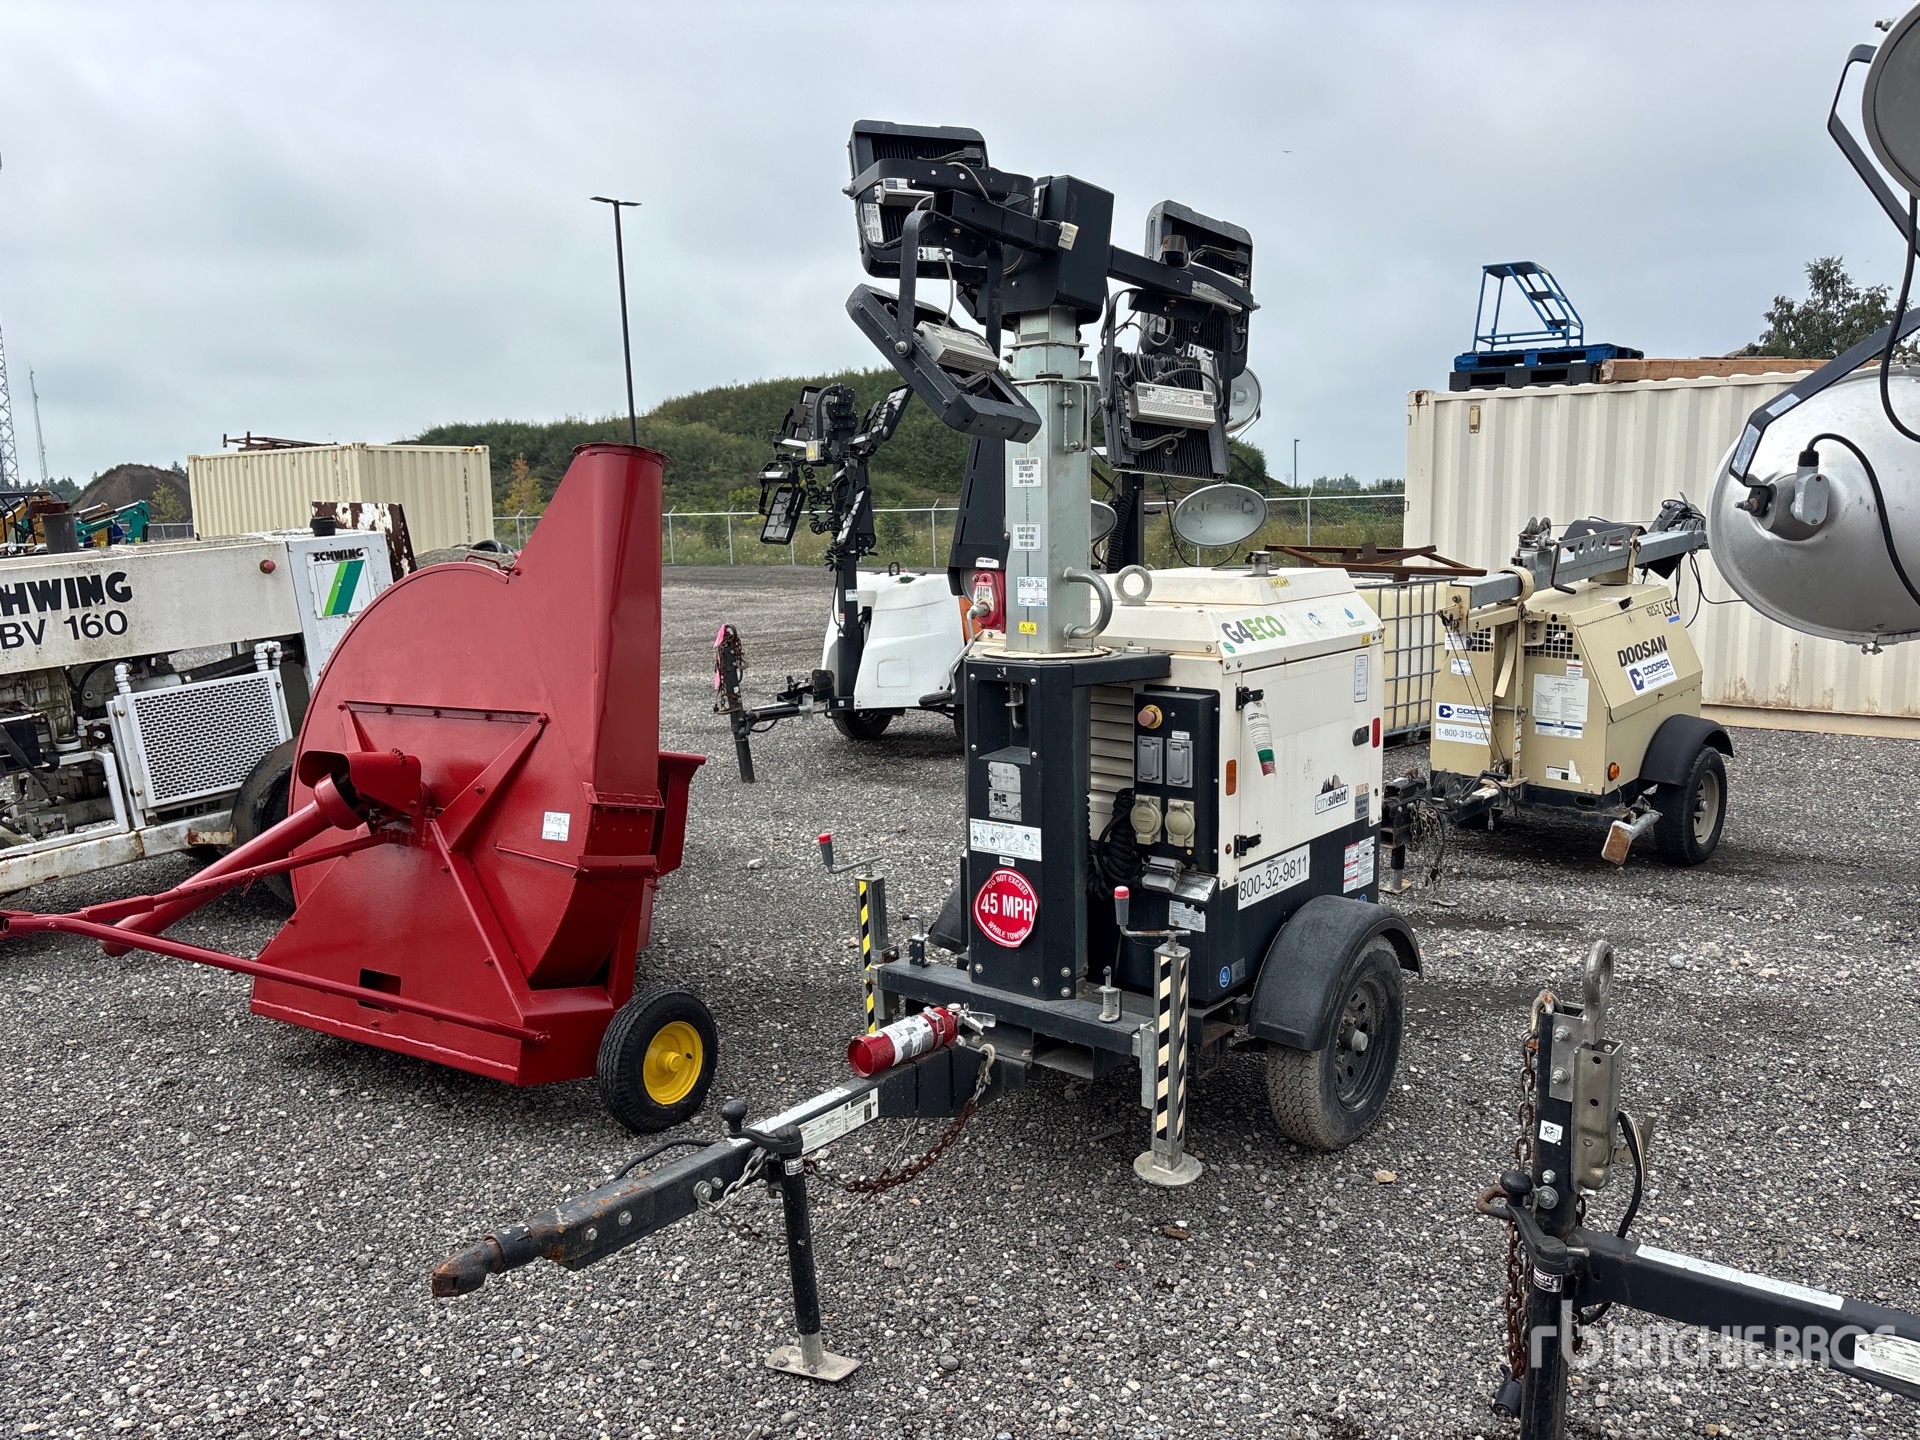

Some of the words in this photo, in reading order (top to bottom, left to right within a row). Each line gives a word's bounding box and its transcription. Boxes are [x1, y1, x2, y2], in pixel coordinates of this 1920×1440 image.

[313, 548, 364, 562] SCHWING
[0, 572, 133, 617] HWING
[63, 610, 128, 641] 160
[1221, 615, 1287, 644] G4ECO
[1617, 635, 1668, 668] DOOSAN
[1642, 659, 1671, 676] COOPER
[987, 880, 996, 889] DO
[1008, 876, 1029, 896] EXCEED
[1240, 854, 1307, 901] 800-32-9811
[980, 892, 999, 915] 45
[1002, 894, 1033, 922] MPH
[987, 920, 1006, 938] WHILE
[1007, 927, 1028, 940] TOWING
